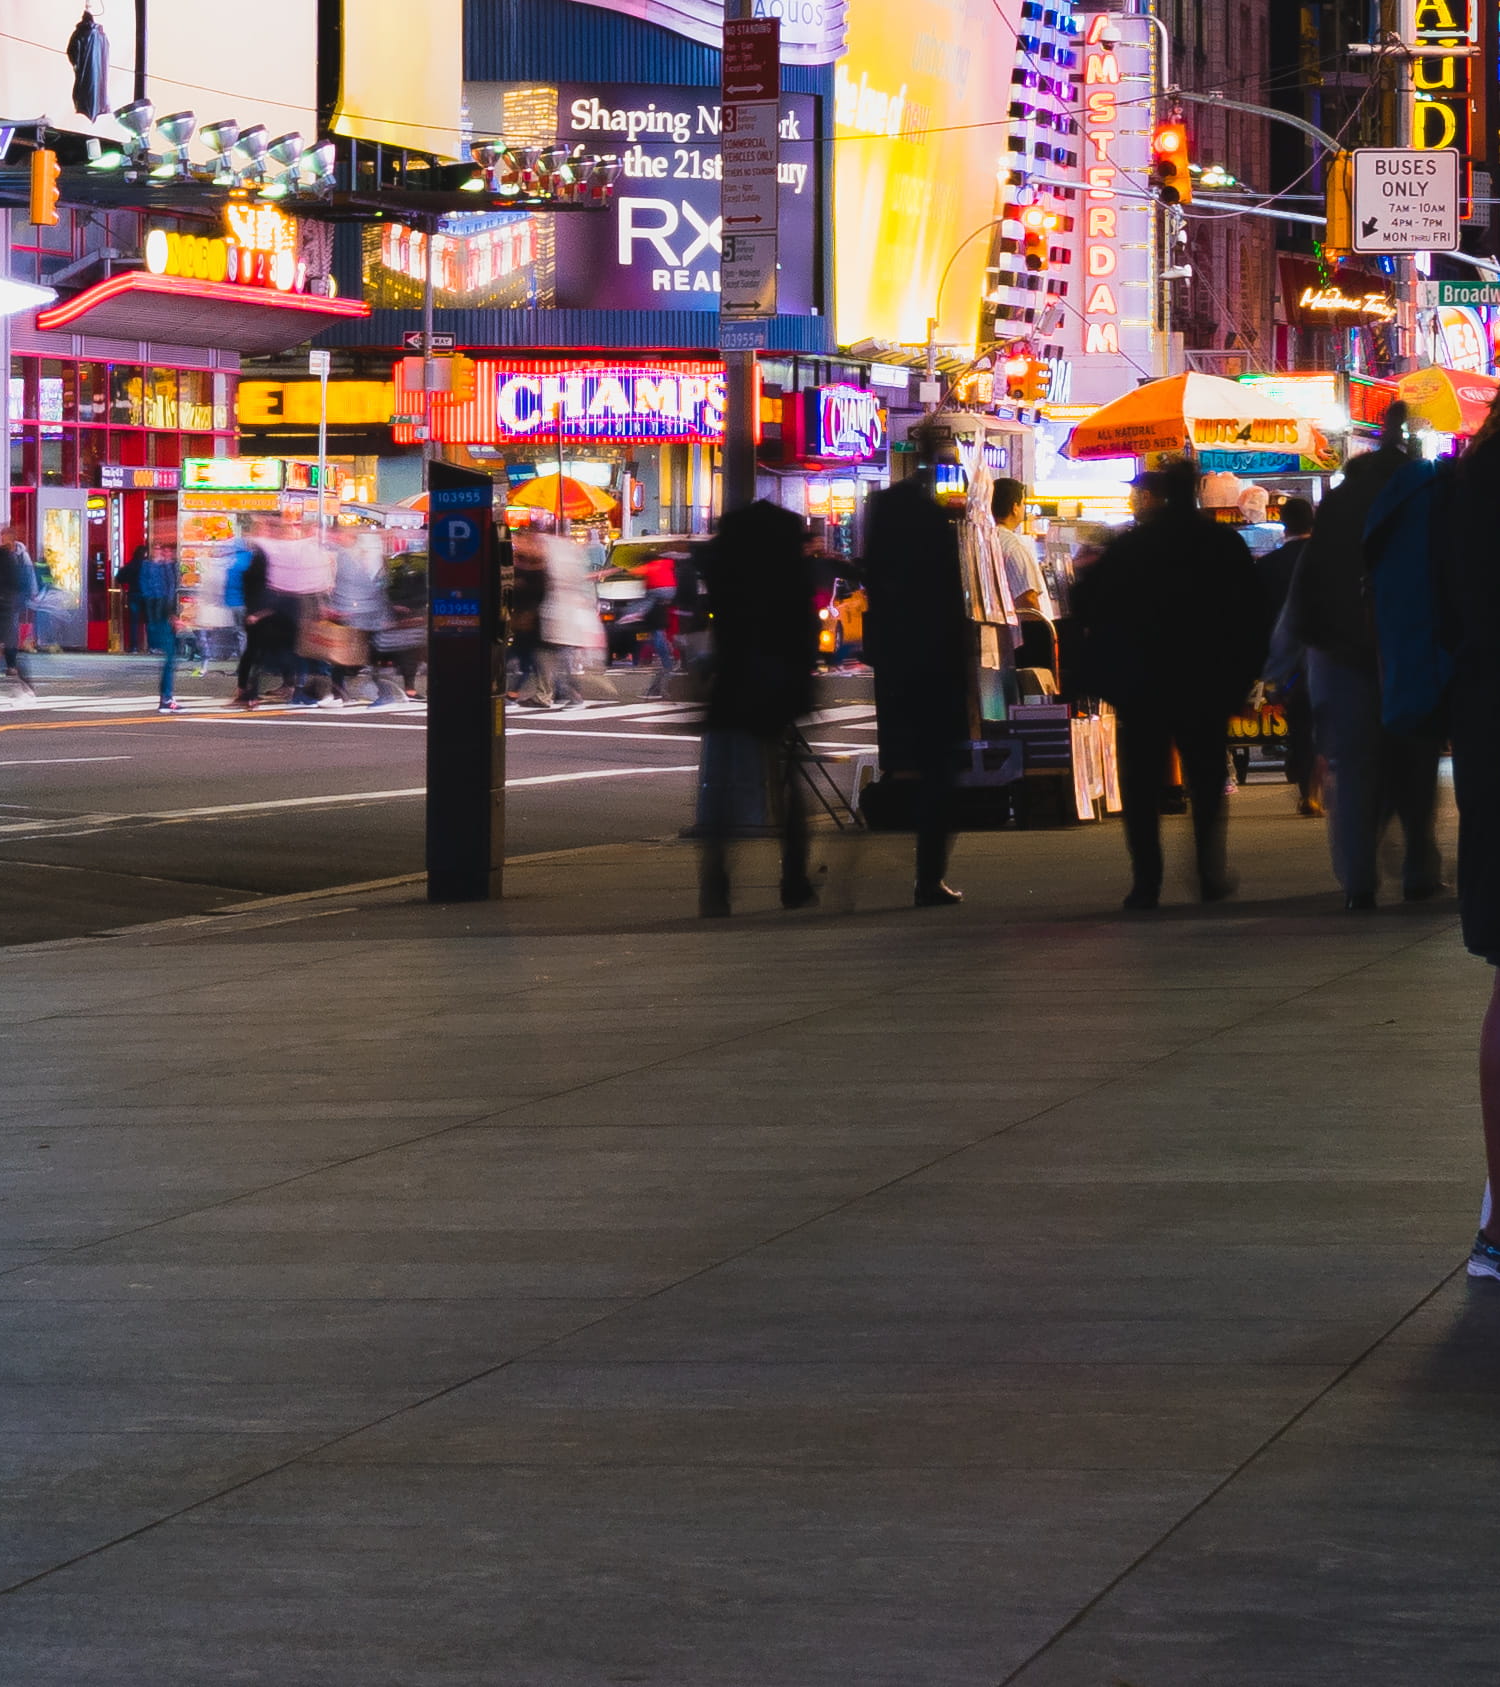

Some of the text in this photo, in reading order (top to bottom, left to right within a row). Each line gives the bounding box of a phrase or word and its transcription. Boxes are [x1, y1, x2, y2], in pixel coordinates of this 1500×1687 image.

[571, 97, 692, 144] Shaping
[724, 108, 734, 131] 3
[623, 144, 668, 179] the
[673, 148, 723, 181] 21st
[1375, 159, 1437, 176] BUSES
[1085, 14, 1120, 354] AMSTERDAM
[1382, 181, 1430, 197] ONLY
[1388, 203, 1410, 213] 7AM
[1419, 203, 1446, 213] 10AM
[1391, 218, 1413, 227] 4PM
[1422, 217, 1443, 227] 7PM
[1383, 232, 1408, 242] MON
[1433, 232, 1451, 242] FRI
[723, 238, 733, 262] 5
[499, 376, 729, 433] CHAMPS
[1096, 424, 1157, 441] ALL NATURAL
[437, 491, 482, 504] 103955
